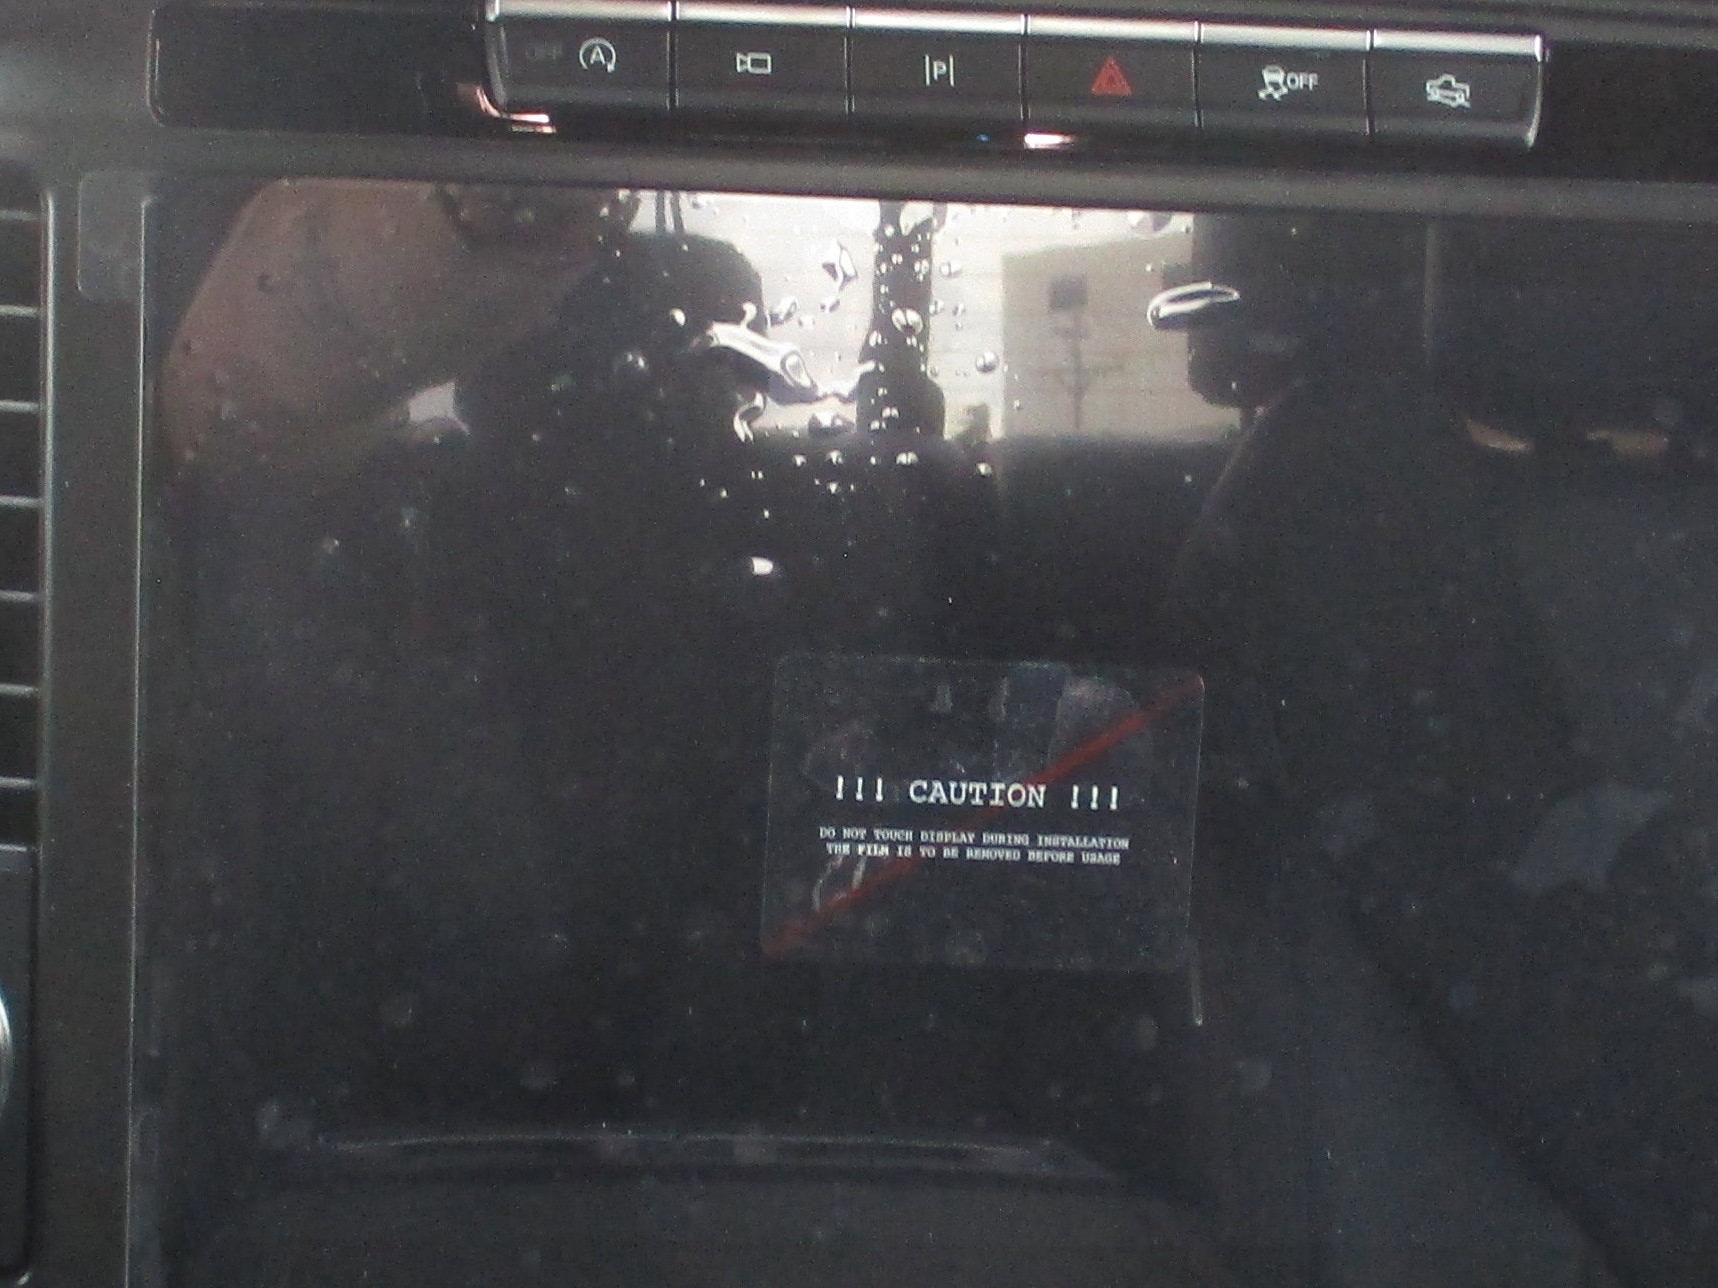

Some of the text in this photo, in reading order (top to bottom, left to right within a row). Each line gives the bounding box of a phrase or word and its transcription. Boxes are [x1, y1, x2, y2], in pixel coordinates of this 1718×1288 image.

[1286, 71, 1318, 91] OFF
[909, 778, 1047, 809] CAUTION
[819, 825, 1130, 851] DO NOT TOUCH DISPLAY DURING INSTALLATION
[825, 841, 1122, 866] THE FILM IS TO BE REMOVED BEFORE USAGE
